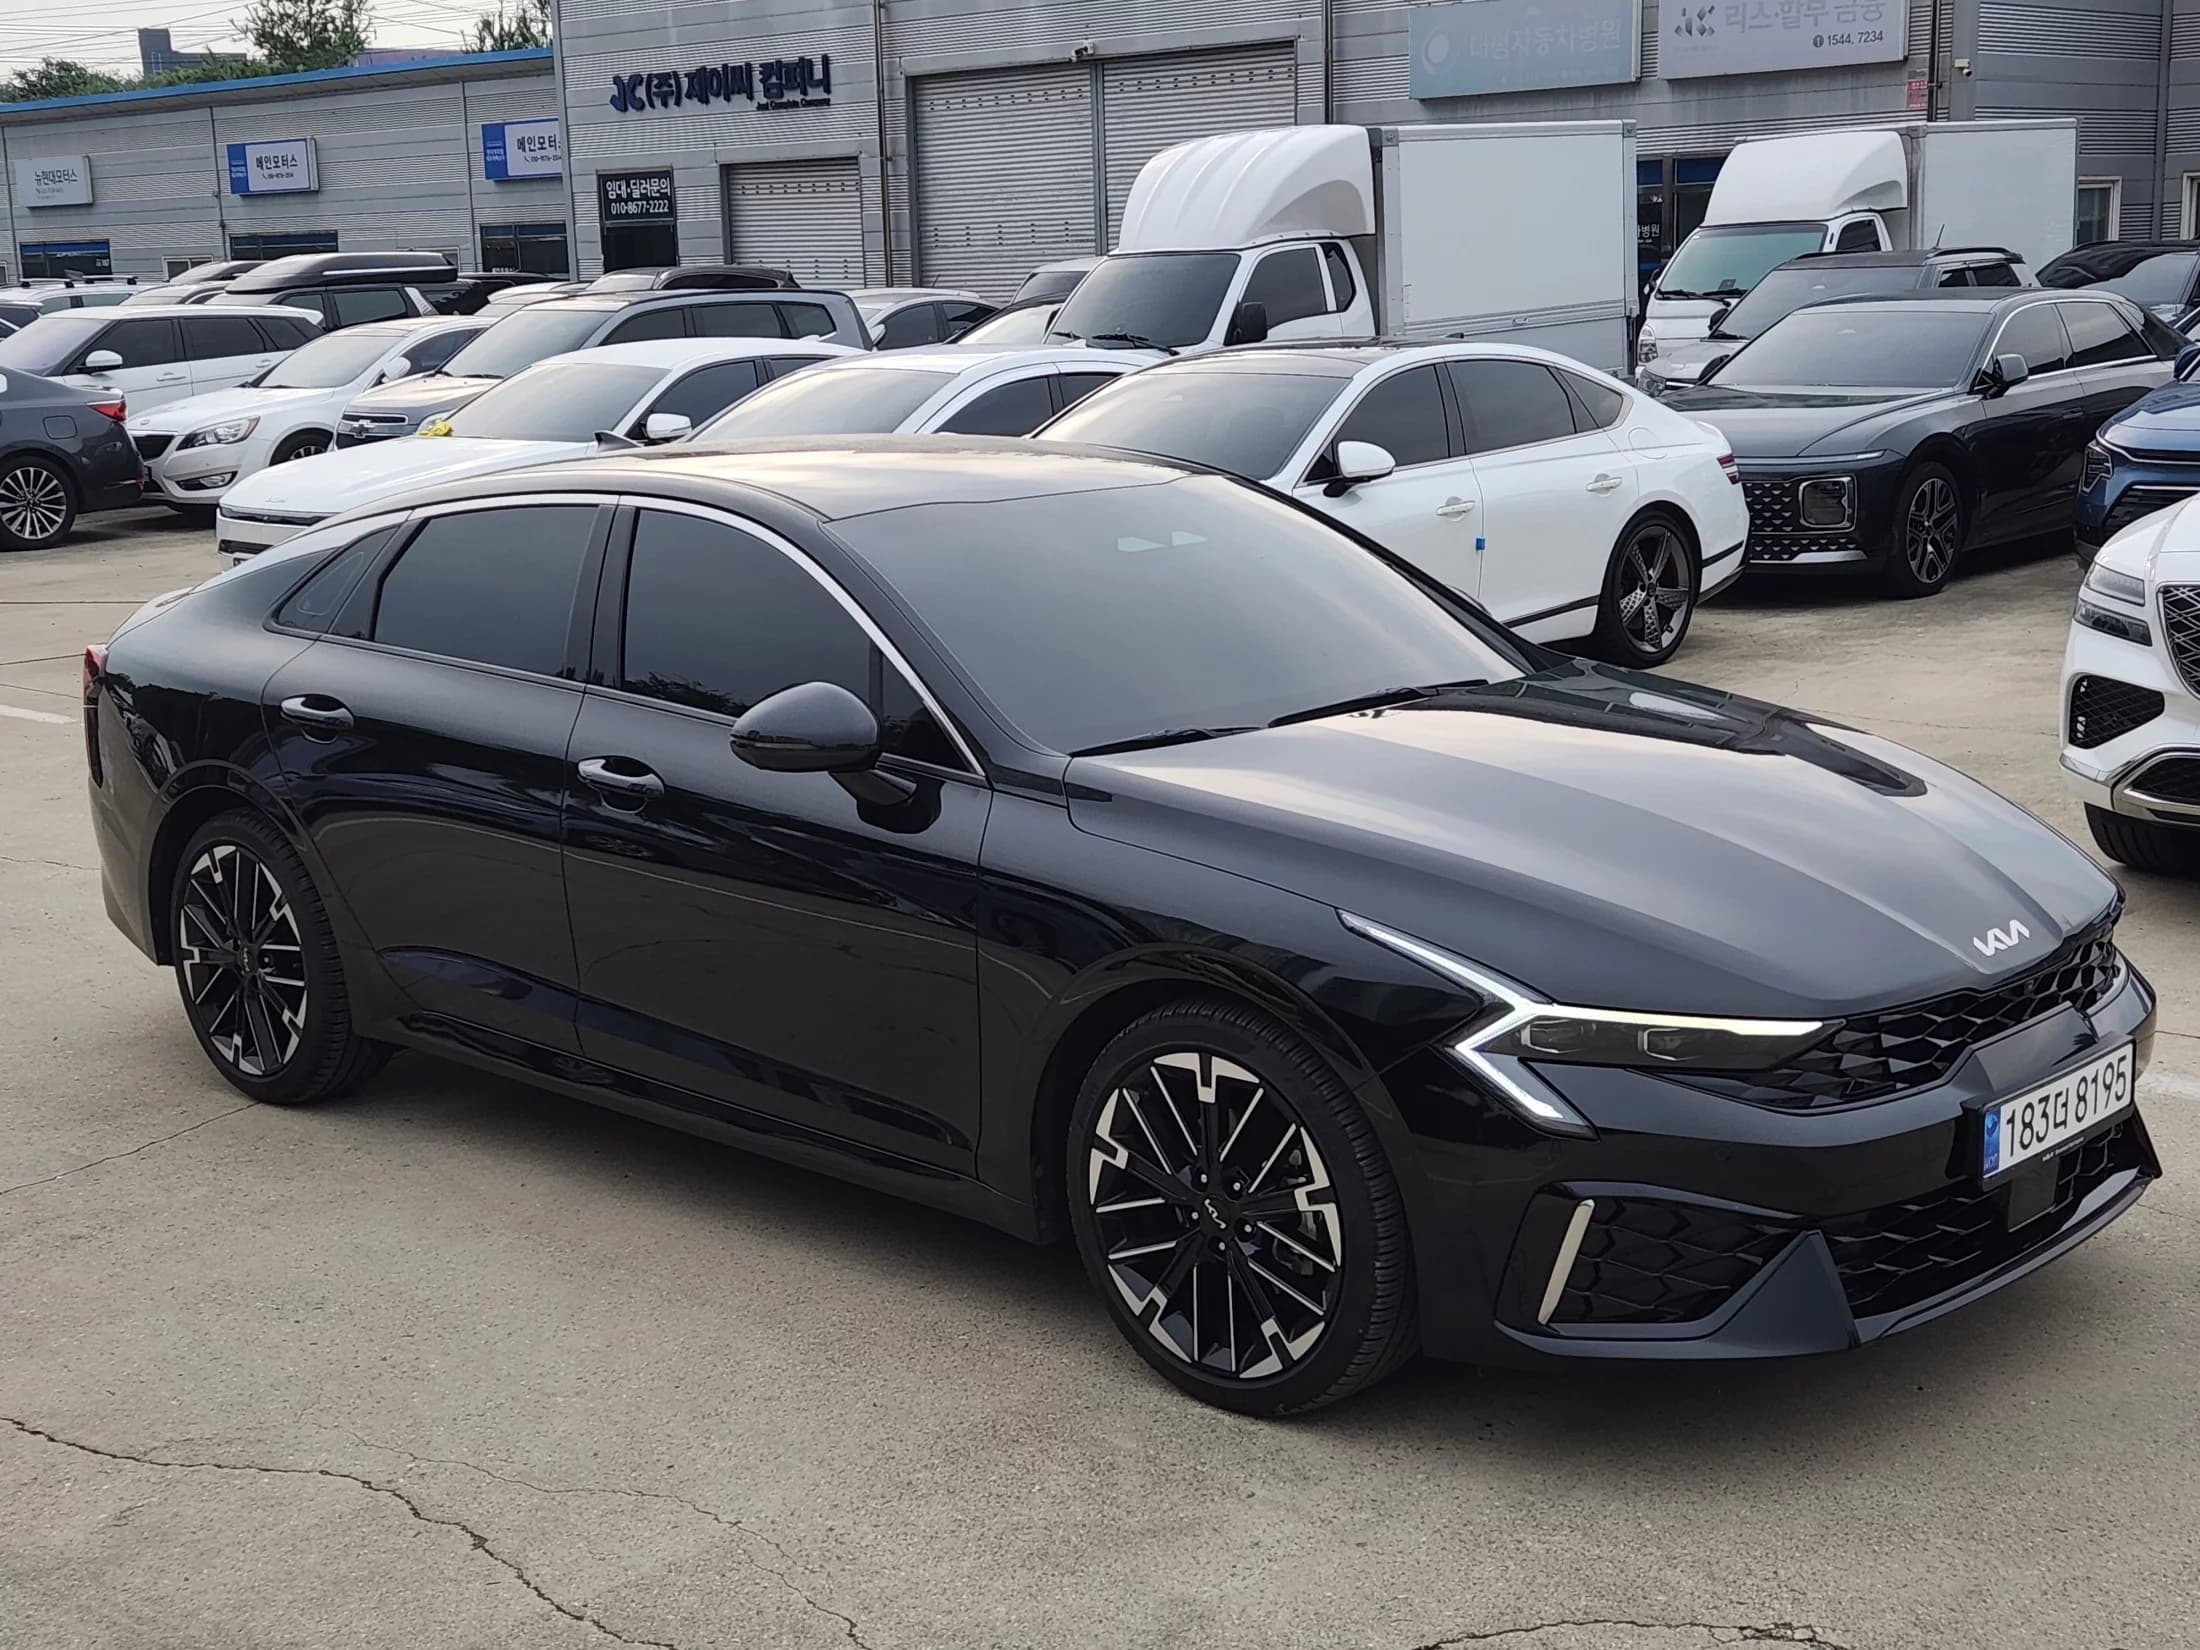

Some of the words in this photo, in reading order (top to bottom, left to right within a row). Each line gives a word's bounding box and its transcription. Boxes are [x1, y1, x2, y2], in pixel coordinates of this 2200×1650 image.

[1857, 30, 1884, 43] 7234
[759, 53, 832, 99] 컴퍼니
[610, 199, 669, 215] 010-8677-2222
[1973, 919, 2030, 957] KIA
[2006, 1087, 2070, 1157] 183더
[2075, 1054, 2127, 1123] 8195
